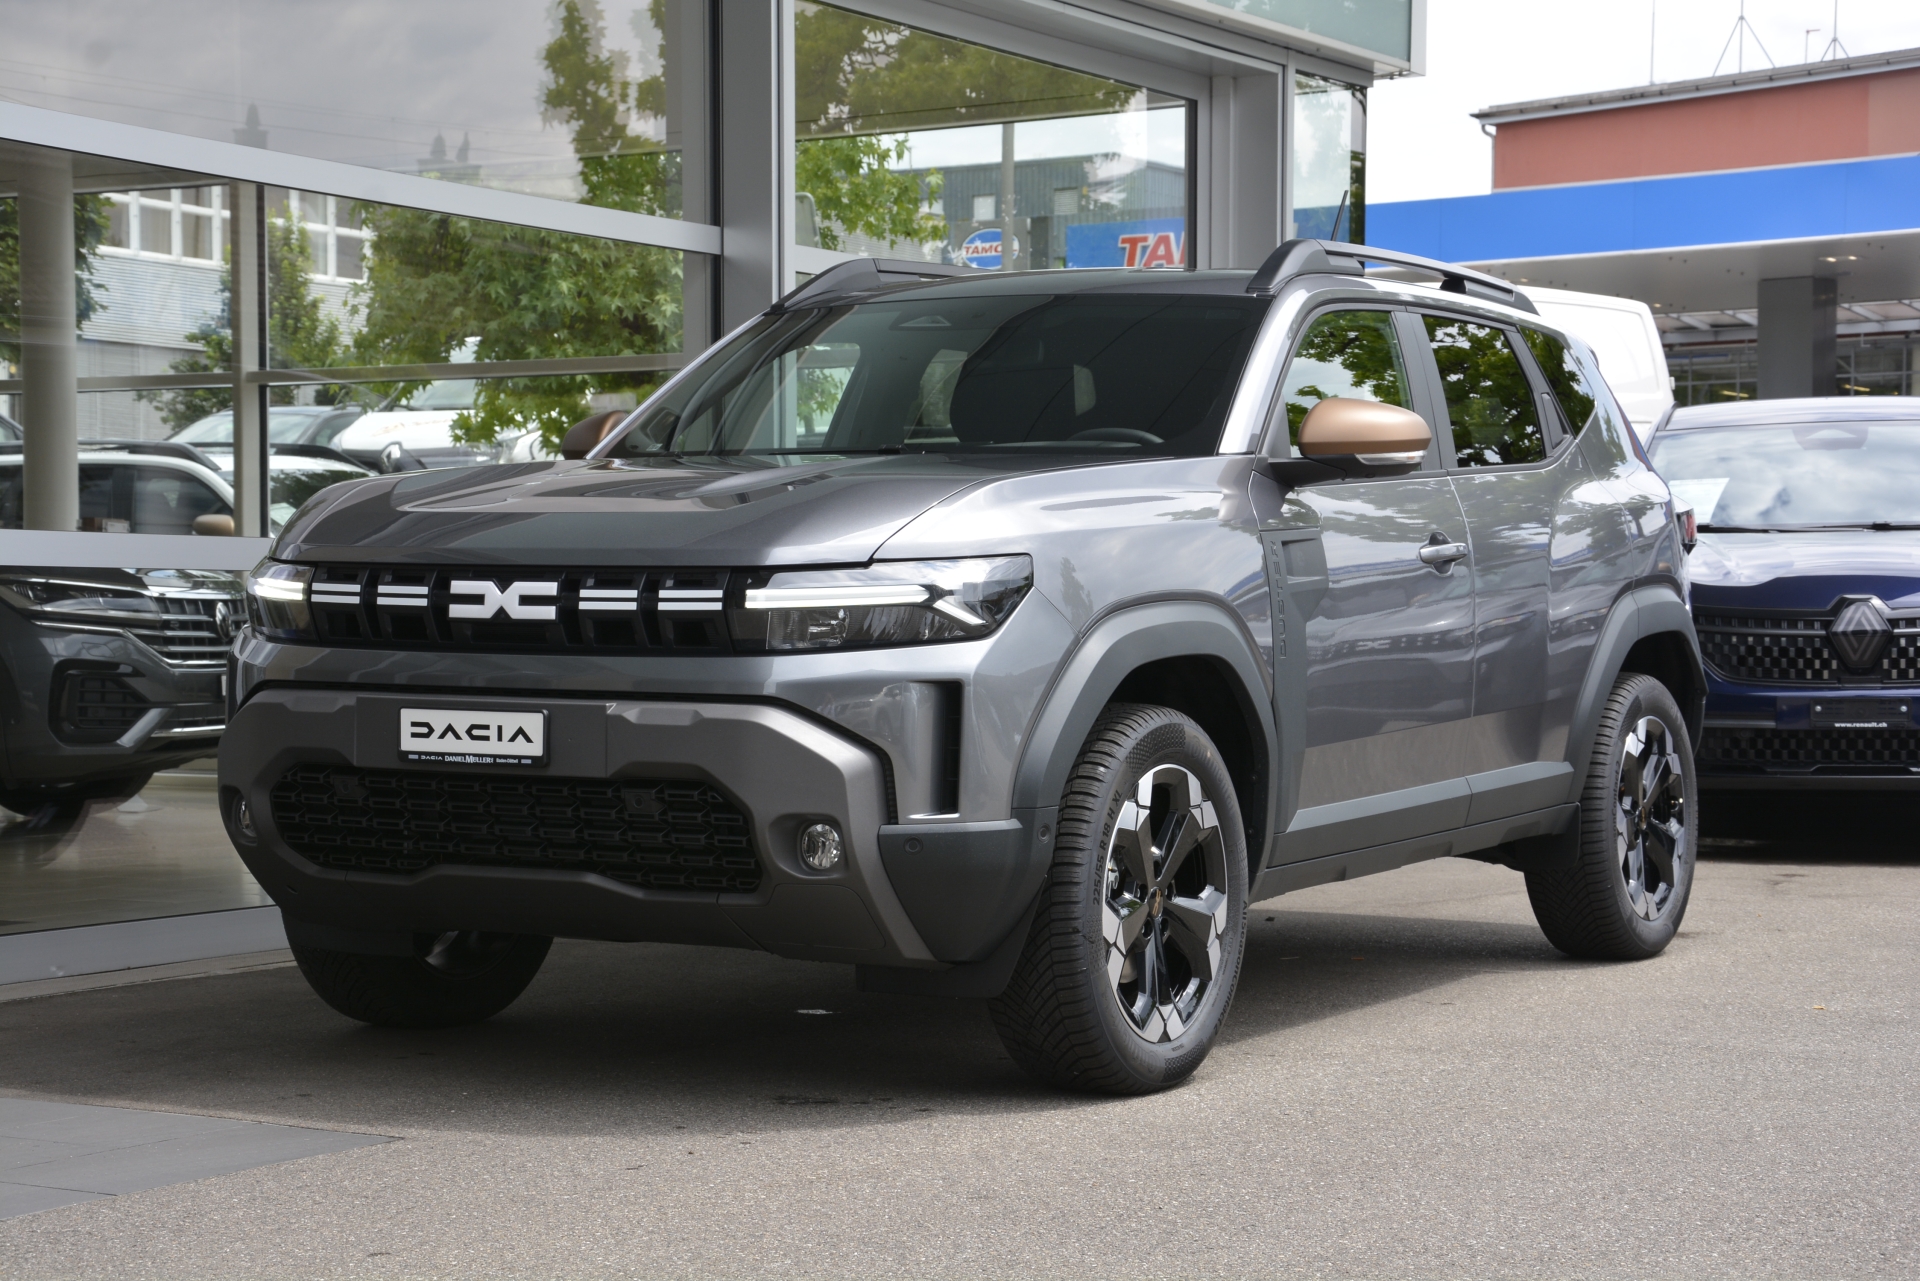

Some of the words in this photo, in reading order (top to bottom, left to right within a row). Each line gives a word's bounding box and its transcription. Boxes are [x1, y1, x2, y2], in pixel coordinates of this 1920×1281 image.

[1118, 231, 1184, 268] TA
[410, 720, 534, 744] DACIA
[1102, 822, 1111, 837] 18
[1099, 840, 1107, 851] R
[1092, 853, 1105, 906] 225/55
